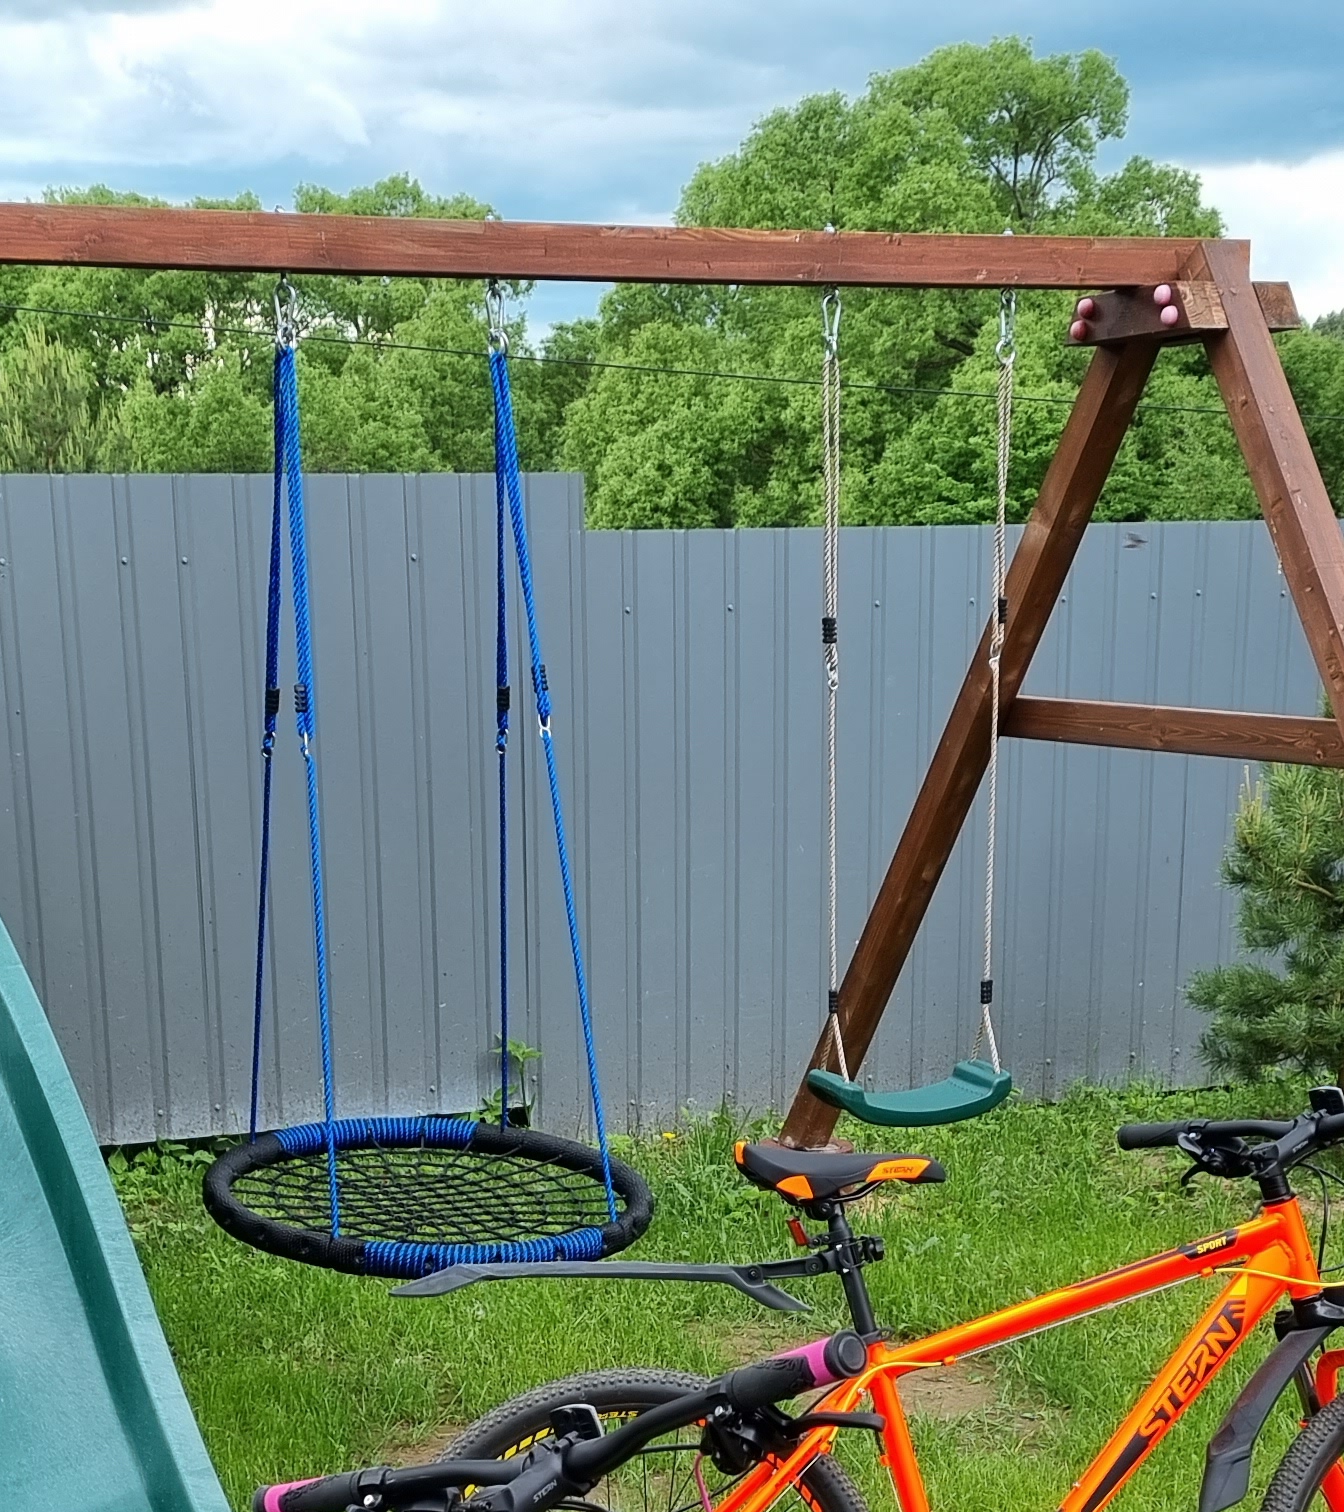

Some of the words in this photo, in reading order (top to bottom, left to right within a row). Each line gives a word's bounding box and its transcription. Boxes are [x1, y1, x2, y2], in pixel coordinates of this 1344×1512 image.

[882, 1166, 914, 1175] STERN
[1196, 1235, 1227, 1254] SPORT
[1139, 1315, 1237, 1445] STERN
[533, 1479, 558, 1503] STERN
